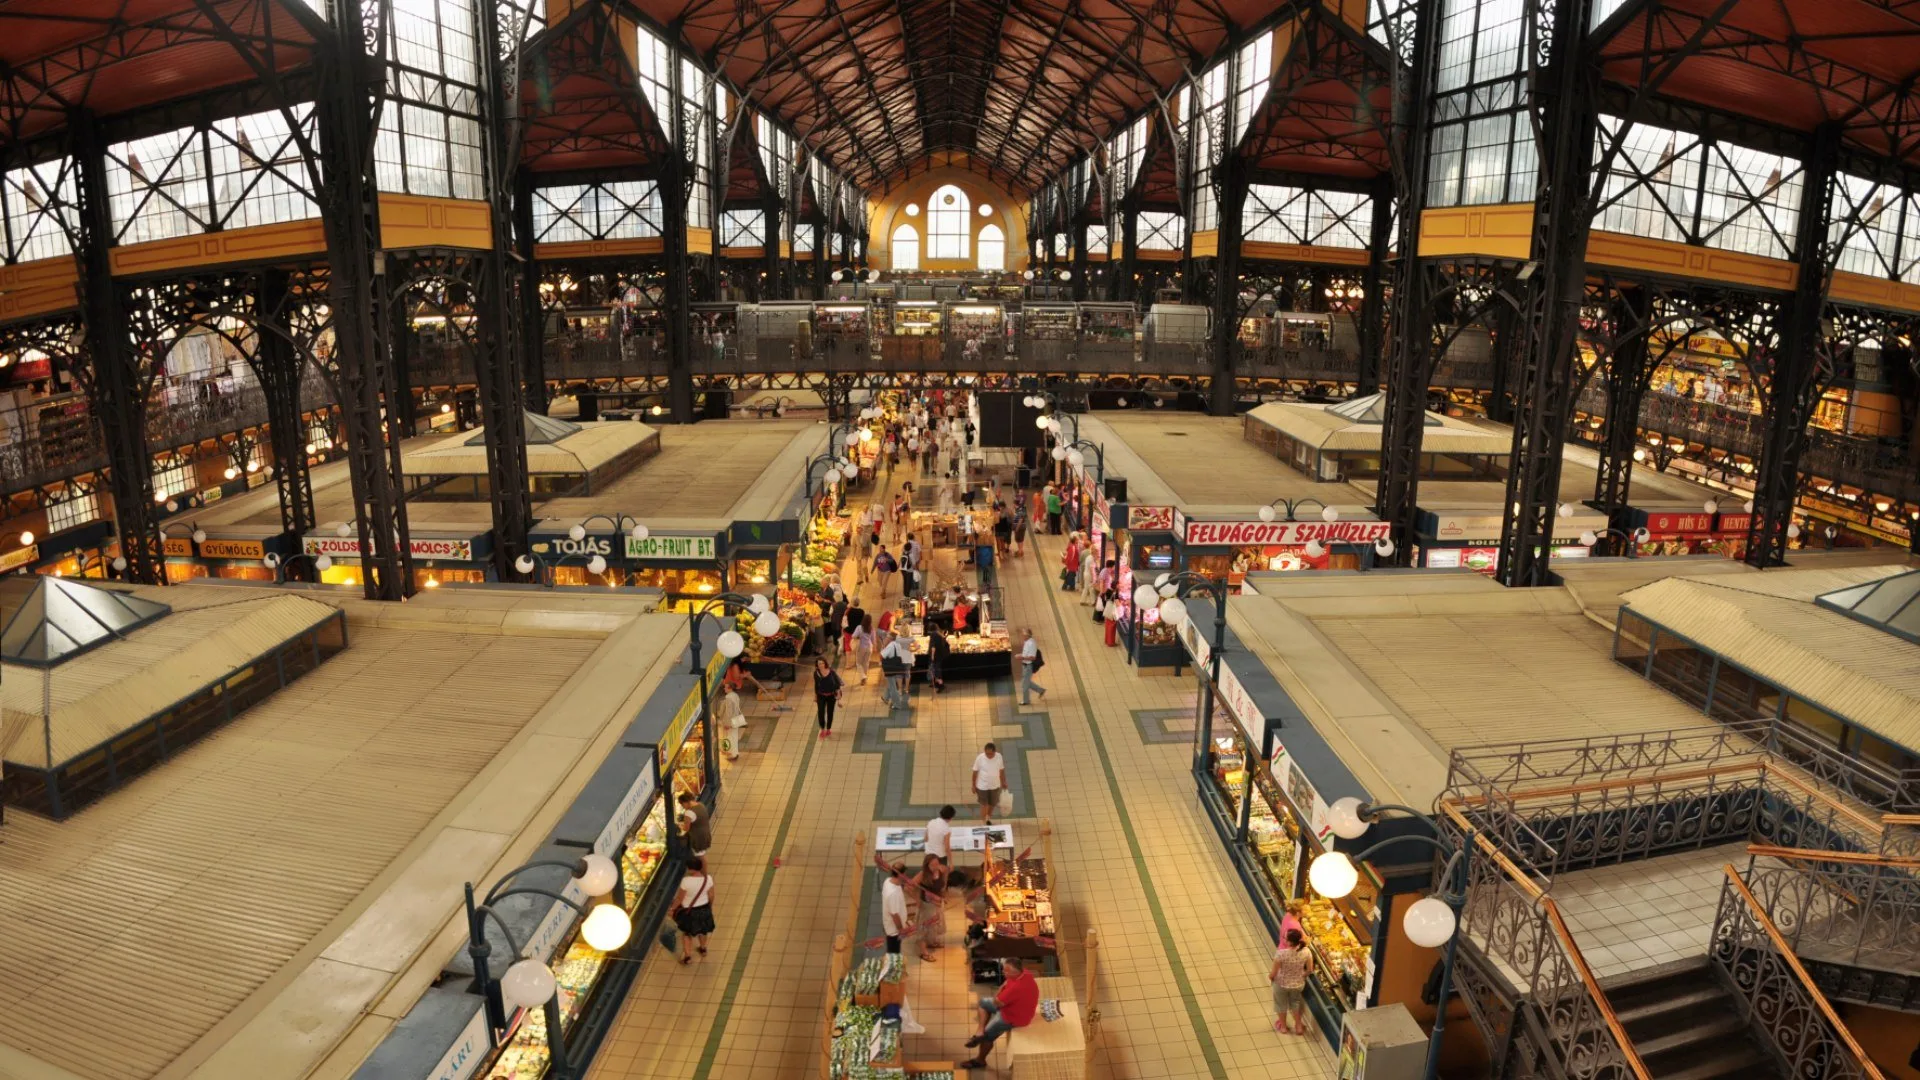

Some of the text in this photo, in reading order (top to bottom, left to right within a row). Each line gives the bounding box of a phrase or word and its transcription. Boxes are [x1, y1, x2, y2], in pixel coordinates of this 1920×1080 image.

[1188, 522, 1390, 544] FELVÁGOTT SZAKÜZLET
[205, 543, 260, 556] GYÜMÖLCS
[552, 537, 612, 555] TOJÁS
[628, 538, 713, 557] AGRO-FRUIT BT.
